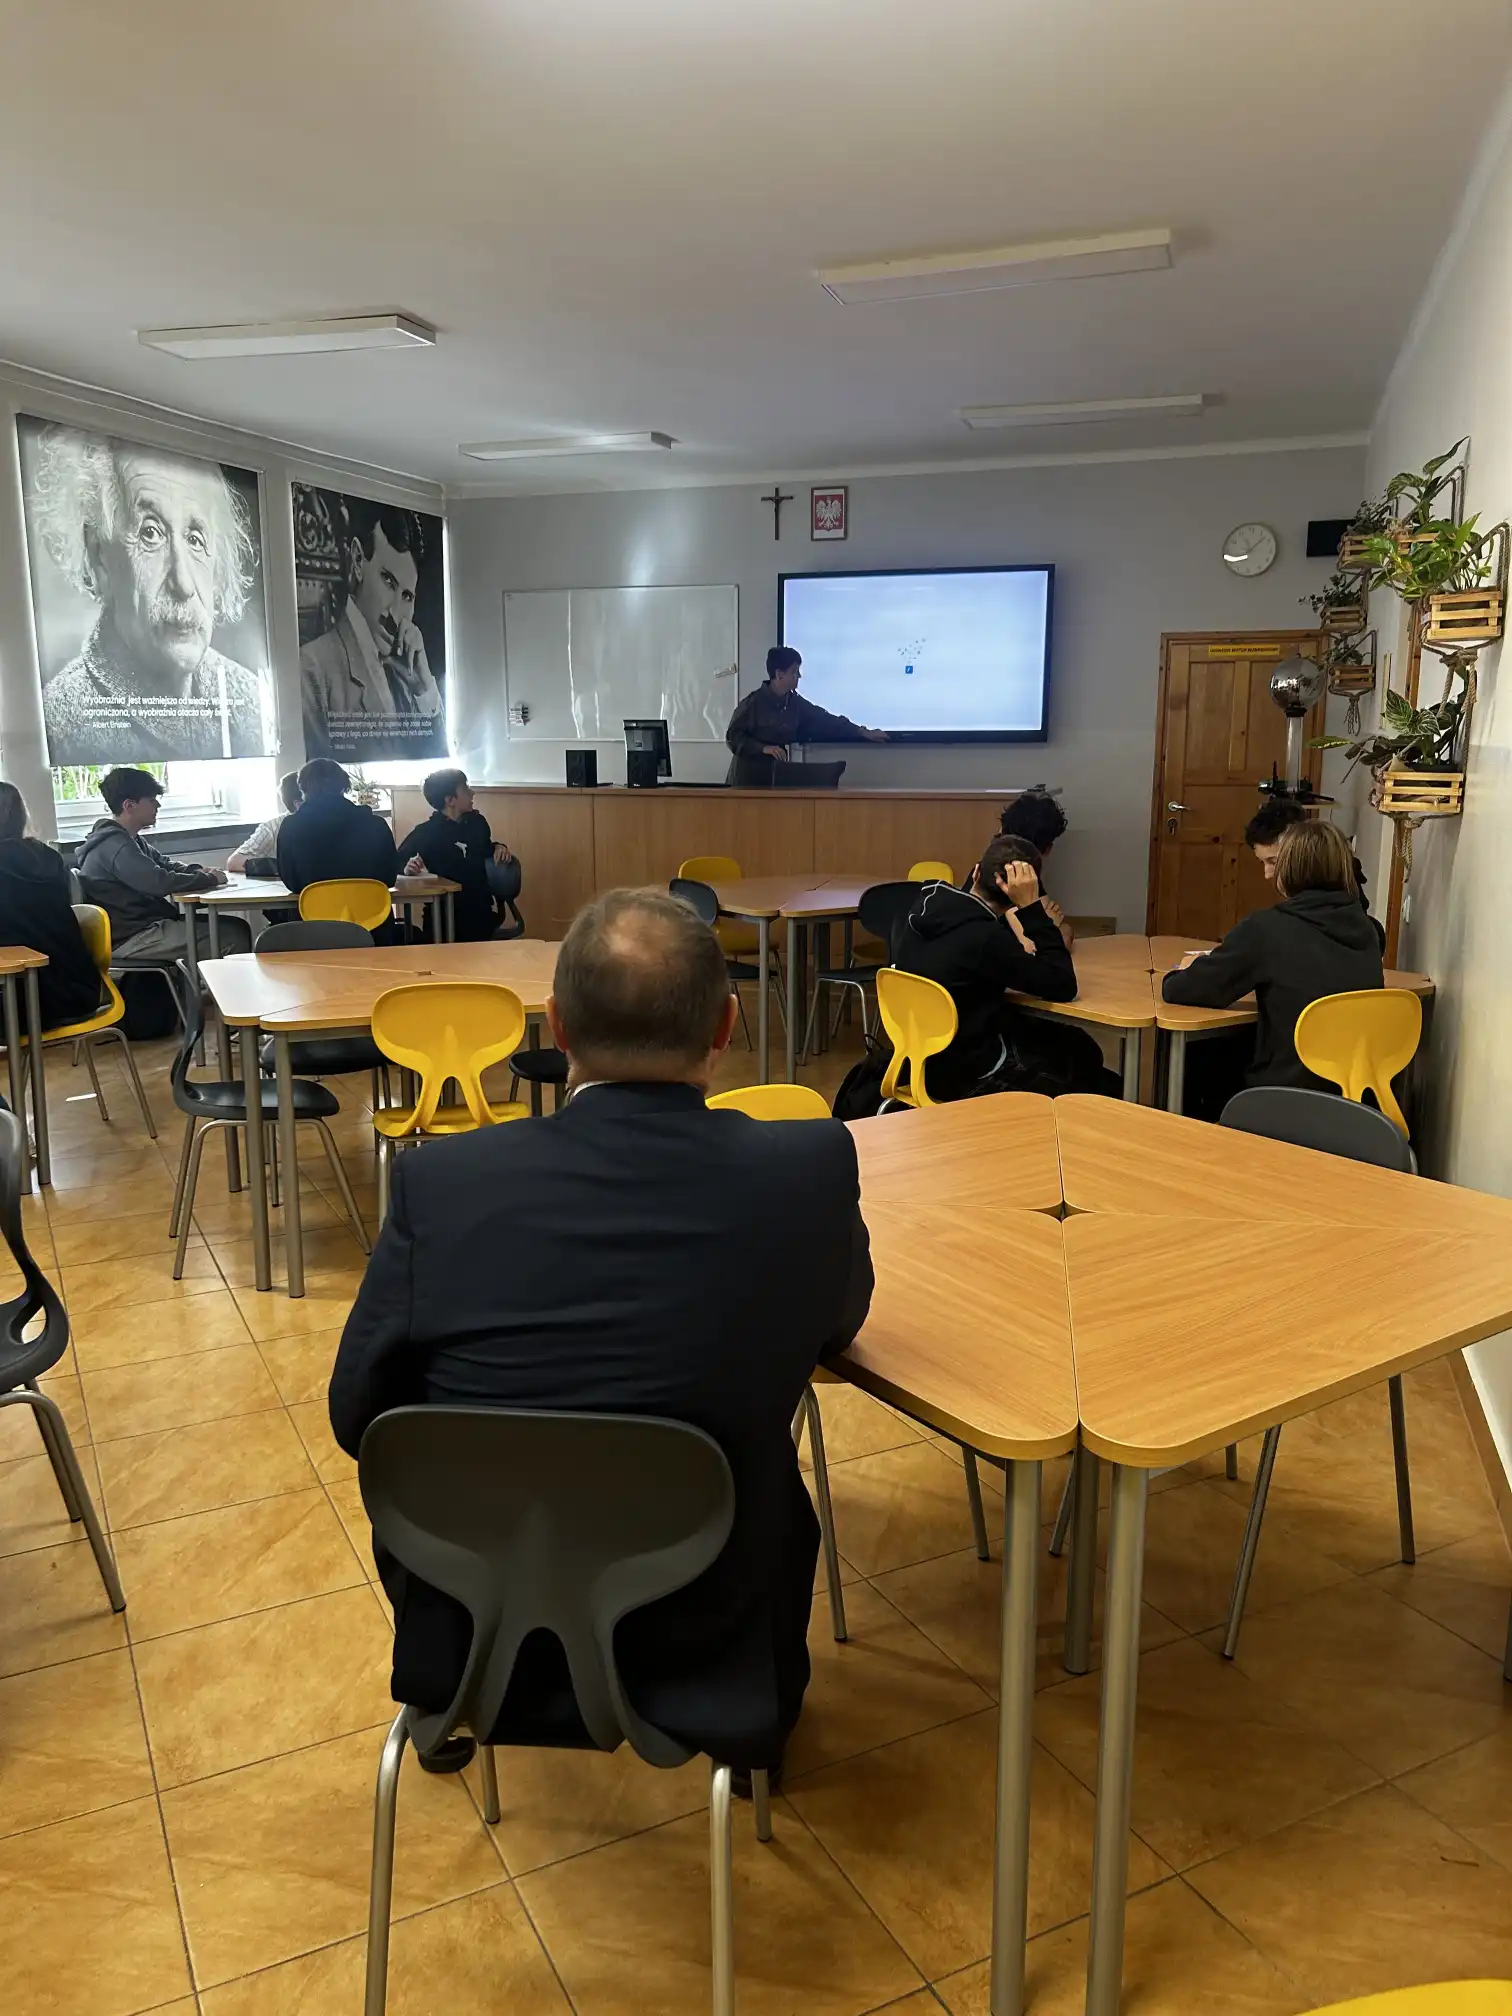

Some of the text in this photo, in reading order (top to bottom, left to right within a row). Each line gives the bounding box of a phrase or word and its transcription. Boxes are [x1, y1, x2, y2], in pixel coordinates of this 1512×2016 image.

[83, 695, 125, 706] Wyobraźnia
[127, 695, 141, 707] jest
[141, 696, 177, 707] ważniejsza
[178, 696, 188, 704] od
[83, 707, 130, 719] ograniczona,
[131, 709, 137, 717] a
[138, 708, 176, 719] wyobraźnia
[177, 708, 199, 717] otacza
